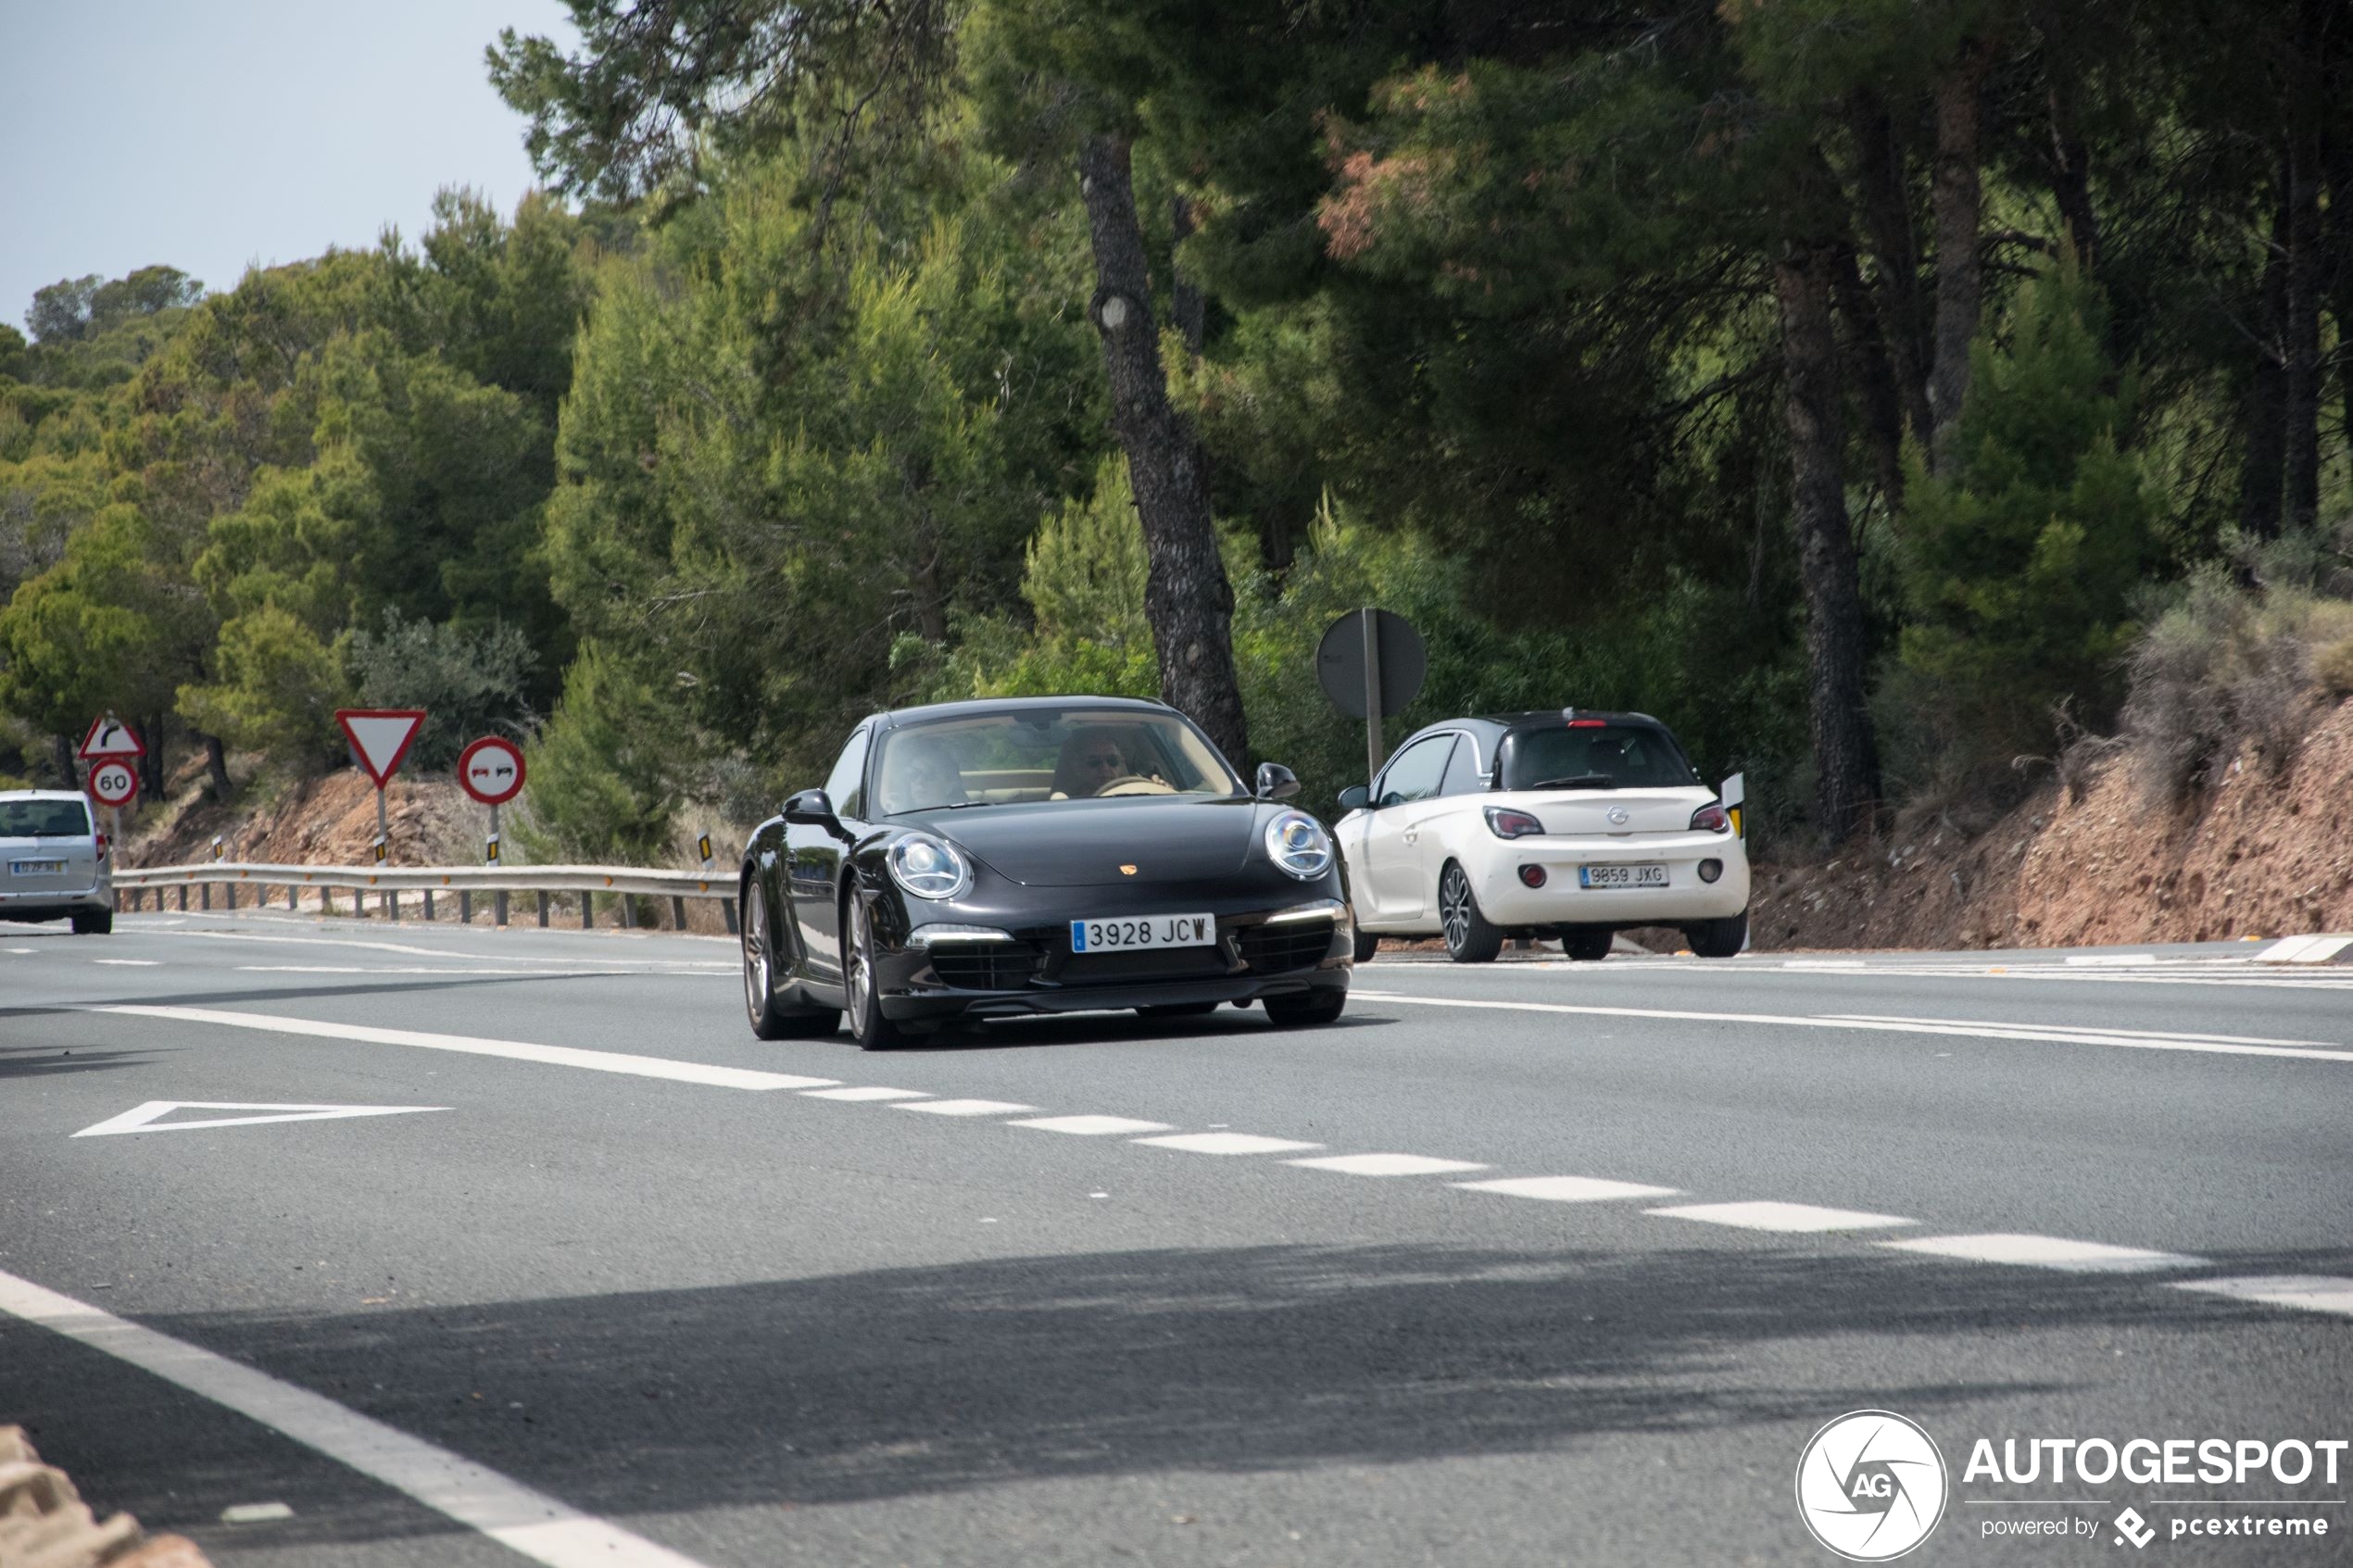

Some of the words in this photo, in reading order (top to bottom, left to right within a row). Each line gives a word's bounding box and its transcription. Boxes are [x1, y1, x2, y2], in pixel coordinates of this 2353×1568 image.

[100, 775, 127, 791] 60
[1591, 868, 1629, 883] 9859
[1635, 867, 1662, 882] JXG
[1089, 922, 1151, 947] 3928
[1162, 918, 1205, 943] JCW
